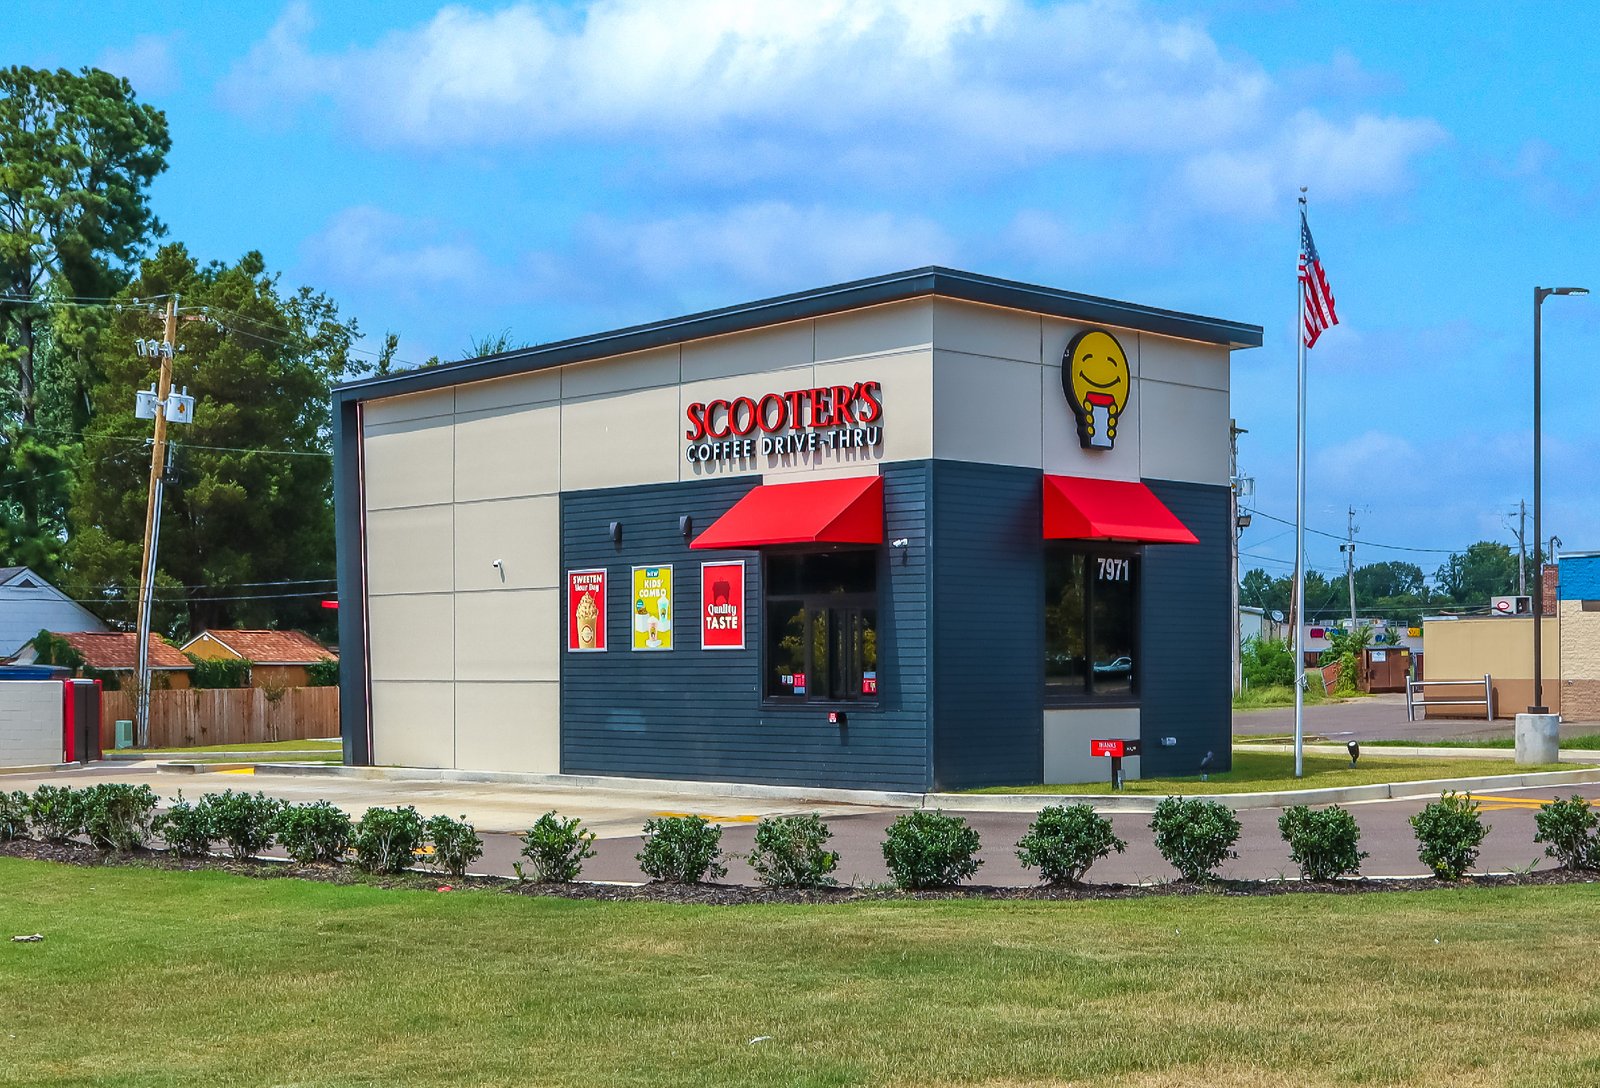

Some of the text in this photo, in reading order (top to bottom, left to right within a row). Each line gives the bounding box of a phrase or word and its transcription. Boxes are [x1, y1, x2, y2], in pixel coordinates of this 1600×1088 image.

[686, 381, 882, 440] SCOOTER'S
[686, 426, 880, 463] COFFEE DRIVE-THRU
[1097, 557, 1129, 581] 7971
[572, 574, 603, 584] SWEETEN
[588, 583, 600, 593] Day
[639, 588, 667, 598] COMBO
[707, 603, 737, 617] Quality
[705, 615, 738, 630] TASTE
